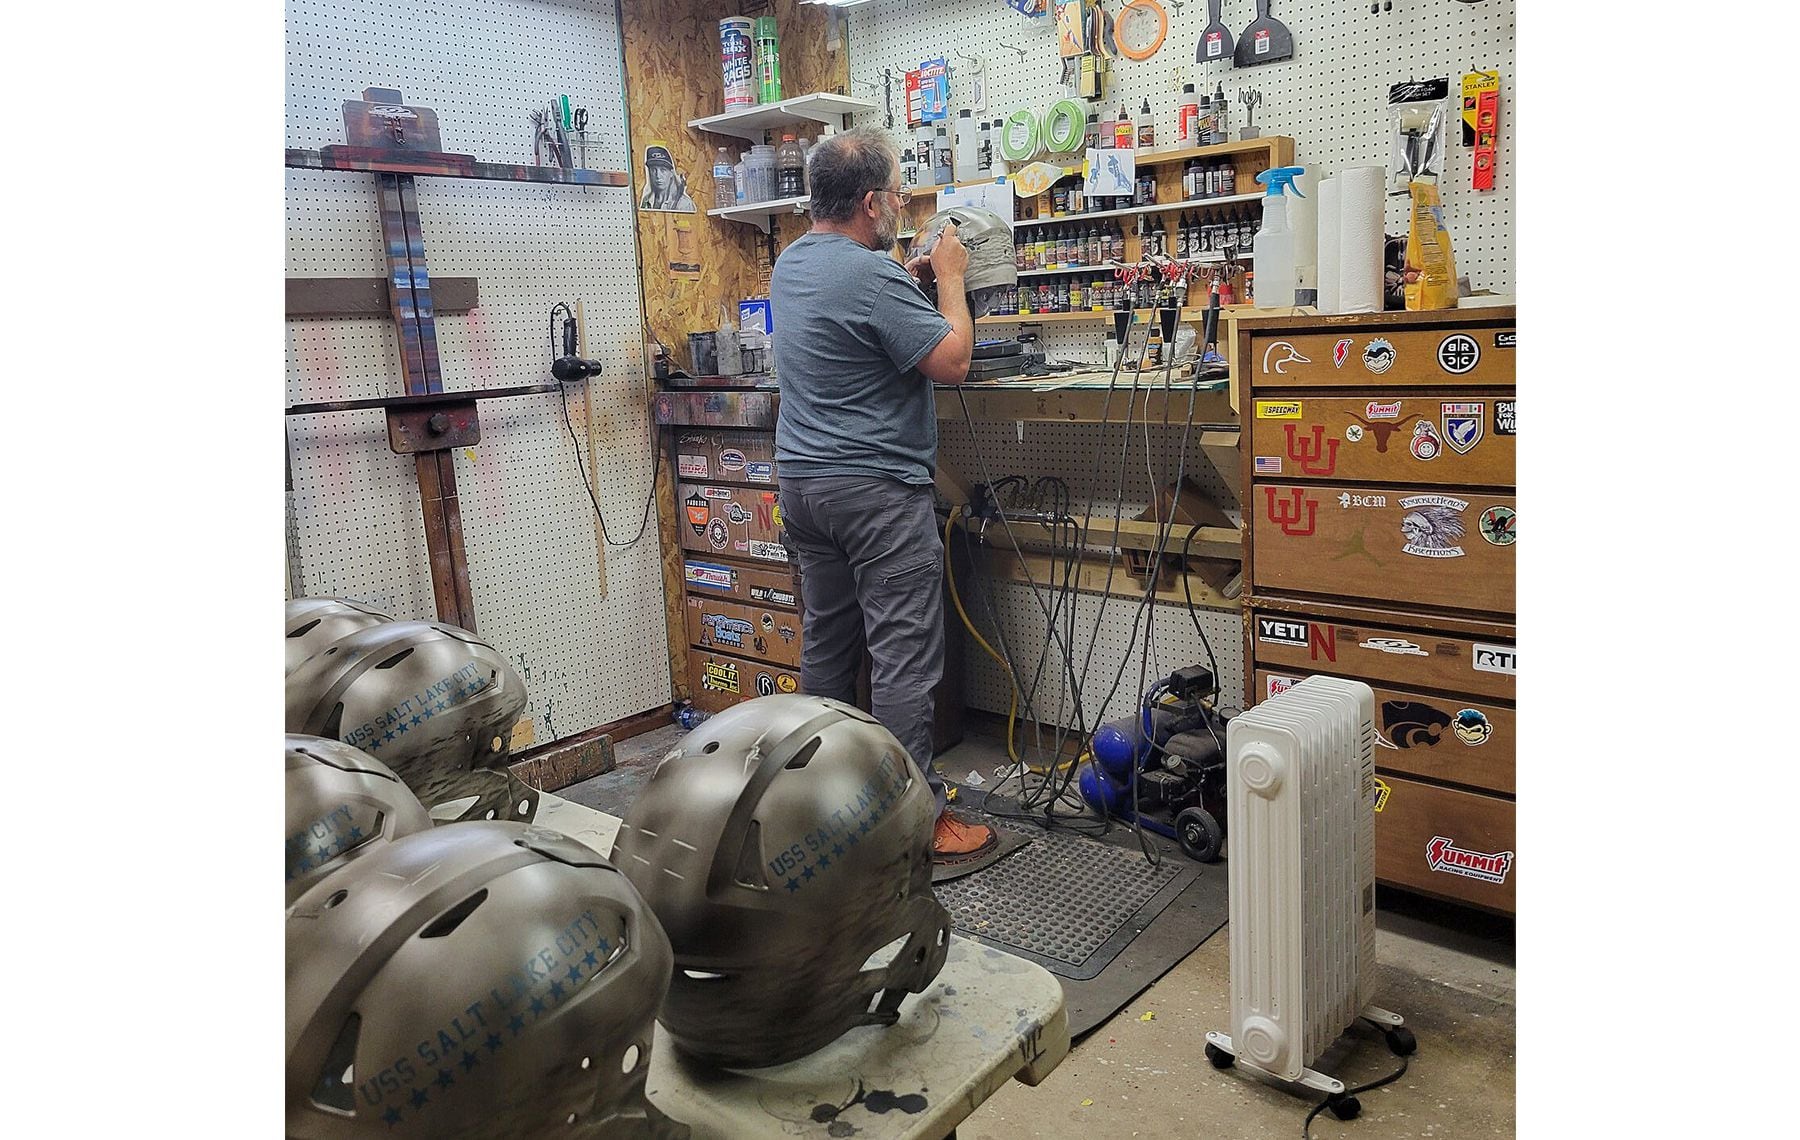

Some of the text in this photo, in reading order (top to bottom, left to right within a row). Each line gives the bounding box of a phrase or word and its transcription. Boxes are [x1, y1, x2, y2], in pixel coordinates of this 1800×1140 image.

[722, 57, 748, 73] WHITE
[724, 66, 752, 87] RAGS
[1465, 82, 1495, 91] STANLEY
[1267, 405, 1299, 416] SPEEDWAY
[1261, 620, 1305, 640] YETI
[1310, 624, 1337, 662] N
[708, 665, 727, 678] COOL
[344, 662, 480, 746] USS SALT LAKE CITY
[769, 843, 806, 877] USS
[805, 809, 848, 852] SALT
[1438, 865, 1504, 883] RACING EQUIPMENT
[359, 1057, 416, 1107] USS
[416, 1000, 488, 1067] SALT
[554, 909, 601, 958] CITY
